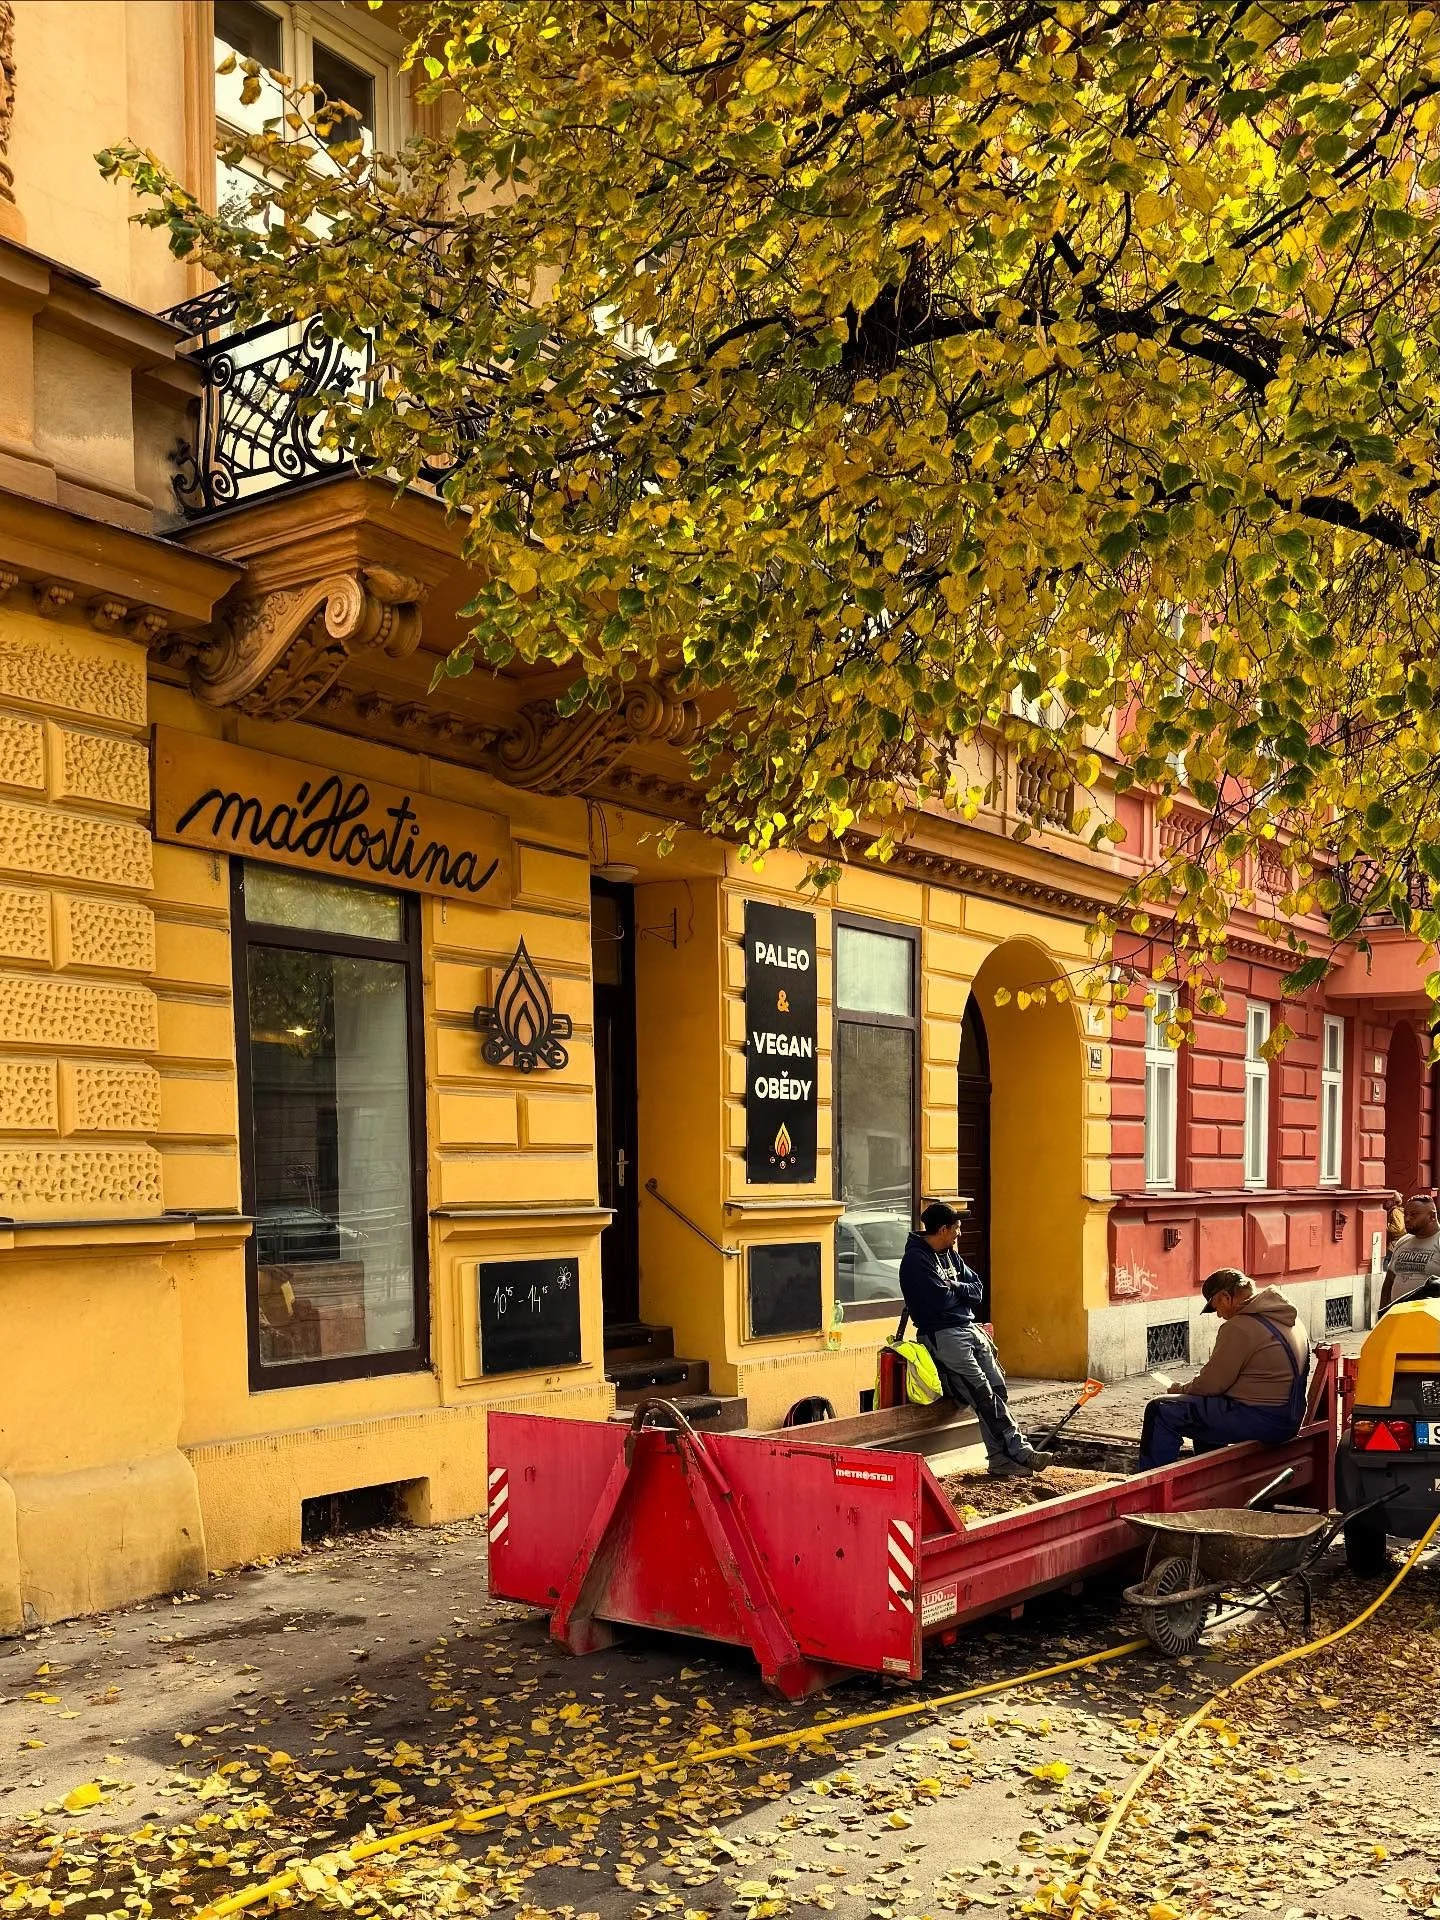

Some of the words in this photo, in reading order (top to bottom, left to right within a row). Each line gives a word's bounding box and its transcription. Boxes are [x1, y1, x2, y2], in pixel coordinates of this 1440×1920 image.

[755, 942, 810, 971] PALEO
[777, 990, 789, 1012] &
[753, 1031, 812, 1058] VEGAN
[755, 1070, 812, 1101] OBĚDY
[922, 1590, 944, 1607] ALDO
